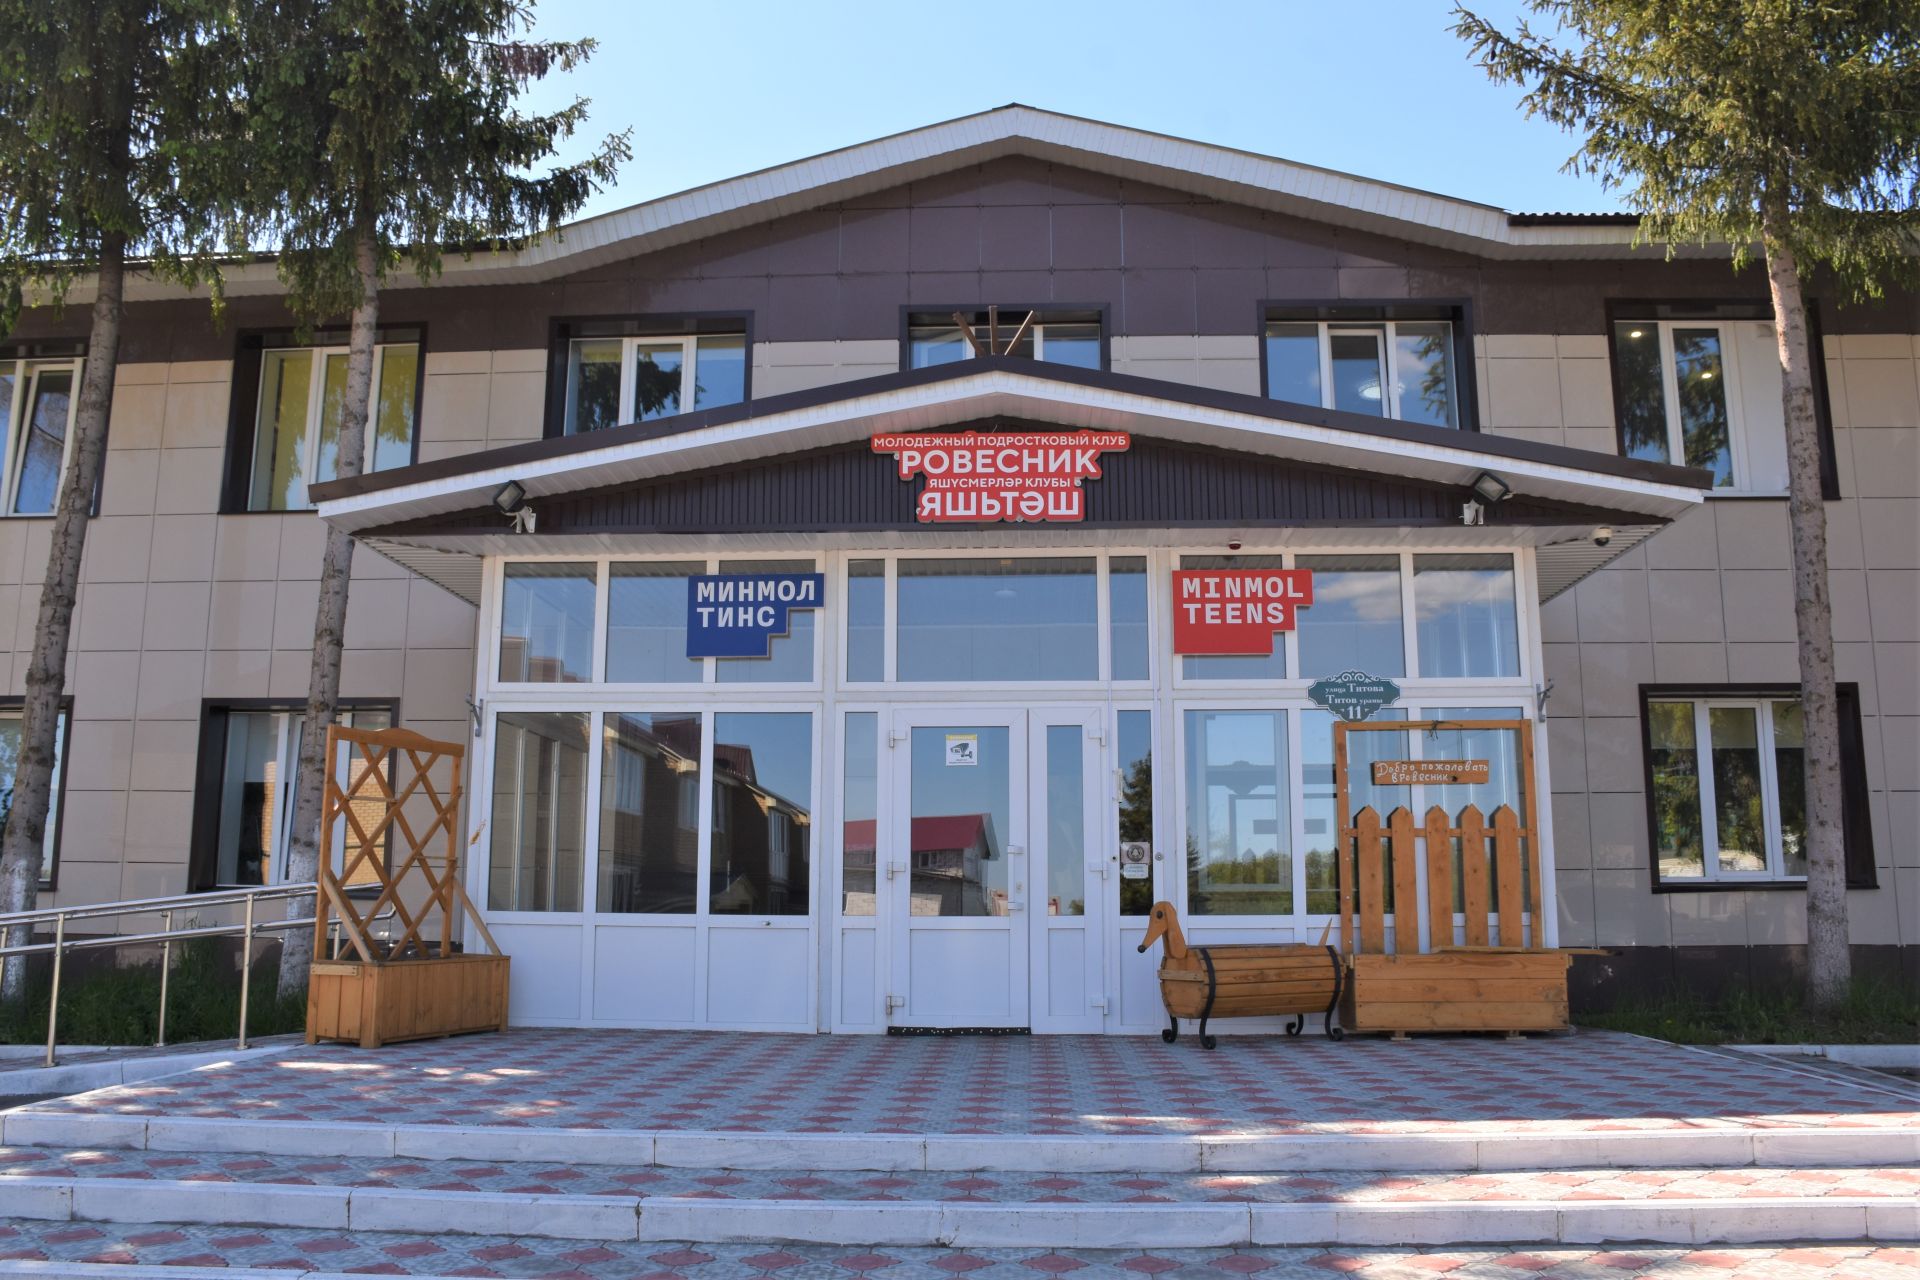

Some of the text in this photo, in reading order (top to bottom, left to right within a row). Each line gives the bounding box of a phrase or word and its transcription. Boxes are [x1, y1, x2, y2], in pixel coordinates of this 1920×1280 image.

[874, 434, 1126, 447] МОЛОДЕЖНЫЙ ПОДРОСТКОВЫЙ КЛУБ
[902, 449, 1097, 474] РОВЕСНИК
[1025, 478, 1071, 488] КЛУБЫ
[921, 491, 1079, 516] ЯШЬТӘШ
[697, 580, 815, 603] МИНМОЛ
[1182, 576, 1304, 599] MINMOL
[696, 606, 775, 628] ТИНС
[1182, 602, 1285, 624] TEENS
[1346, 683, 1384, 693] Титова
[1346, 705, 1362, 719] 11
[1376, 760, 1488, 777] Добро пожаловать
